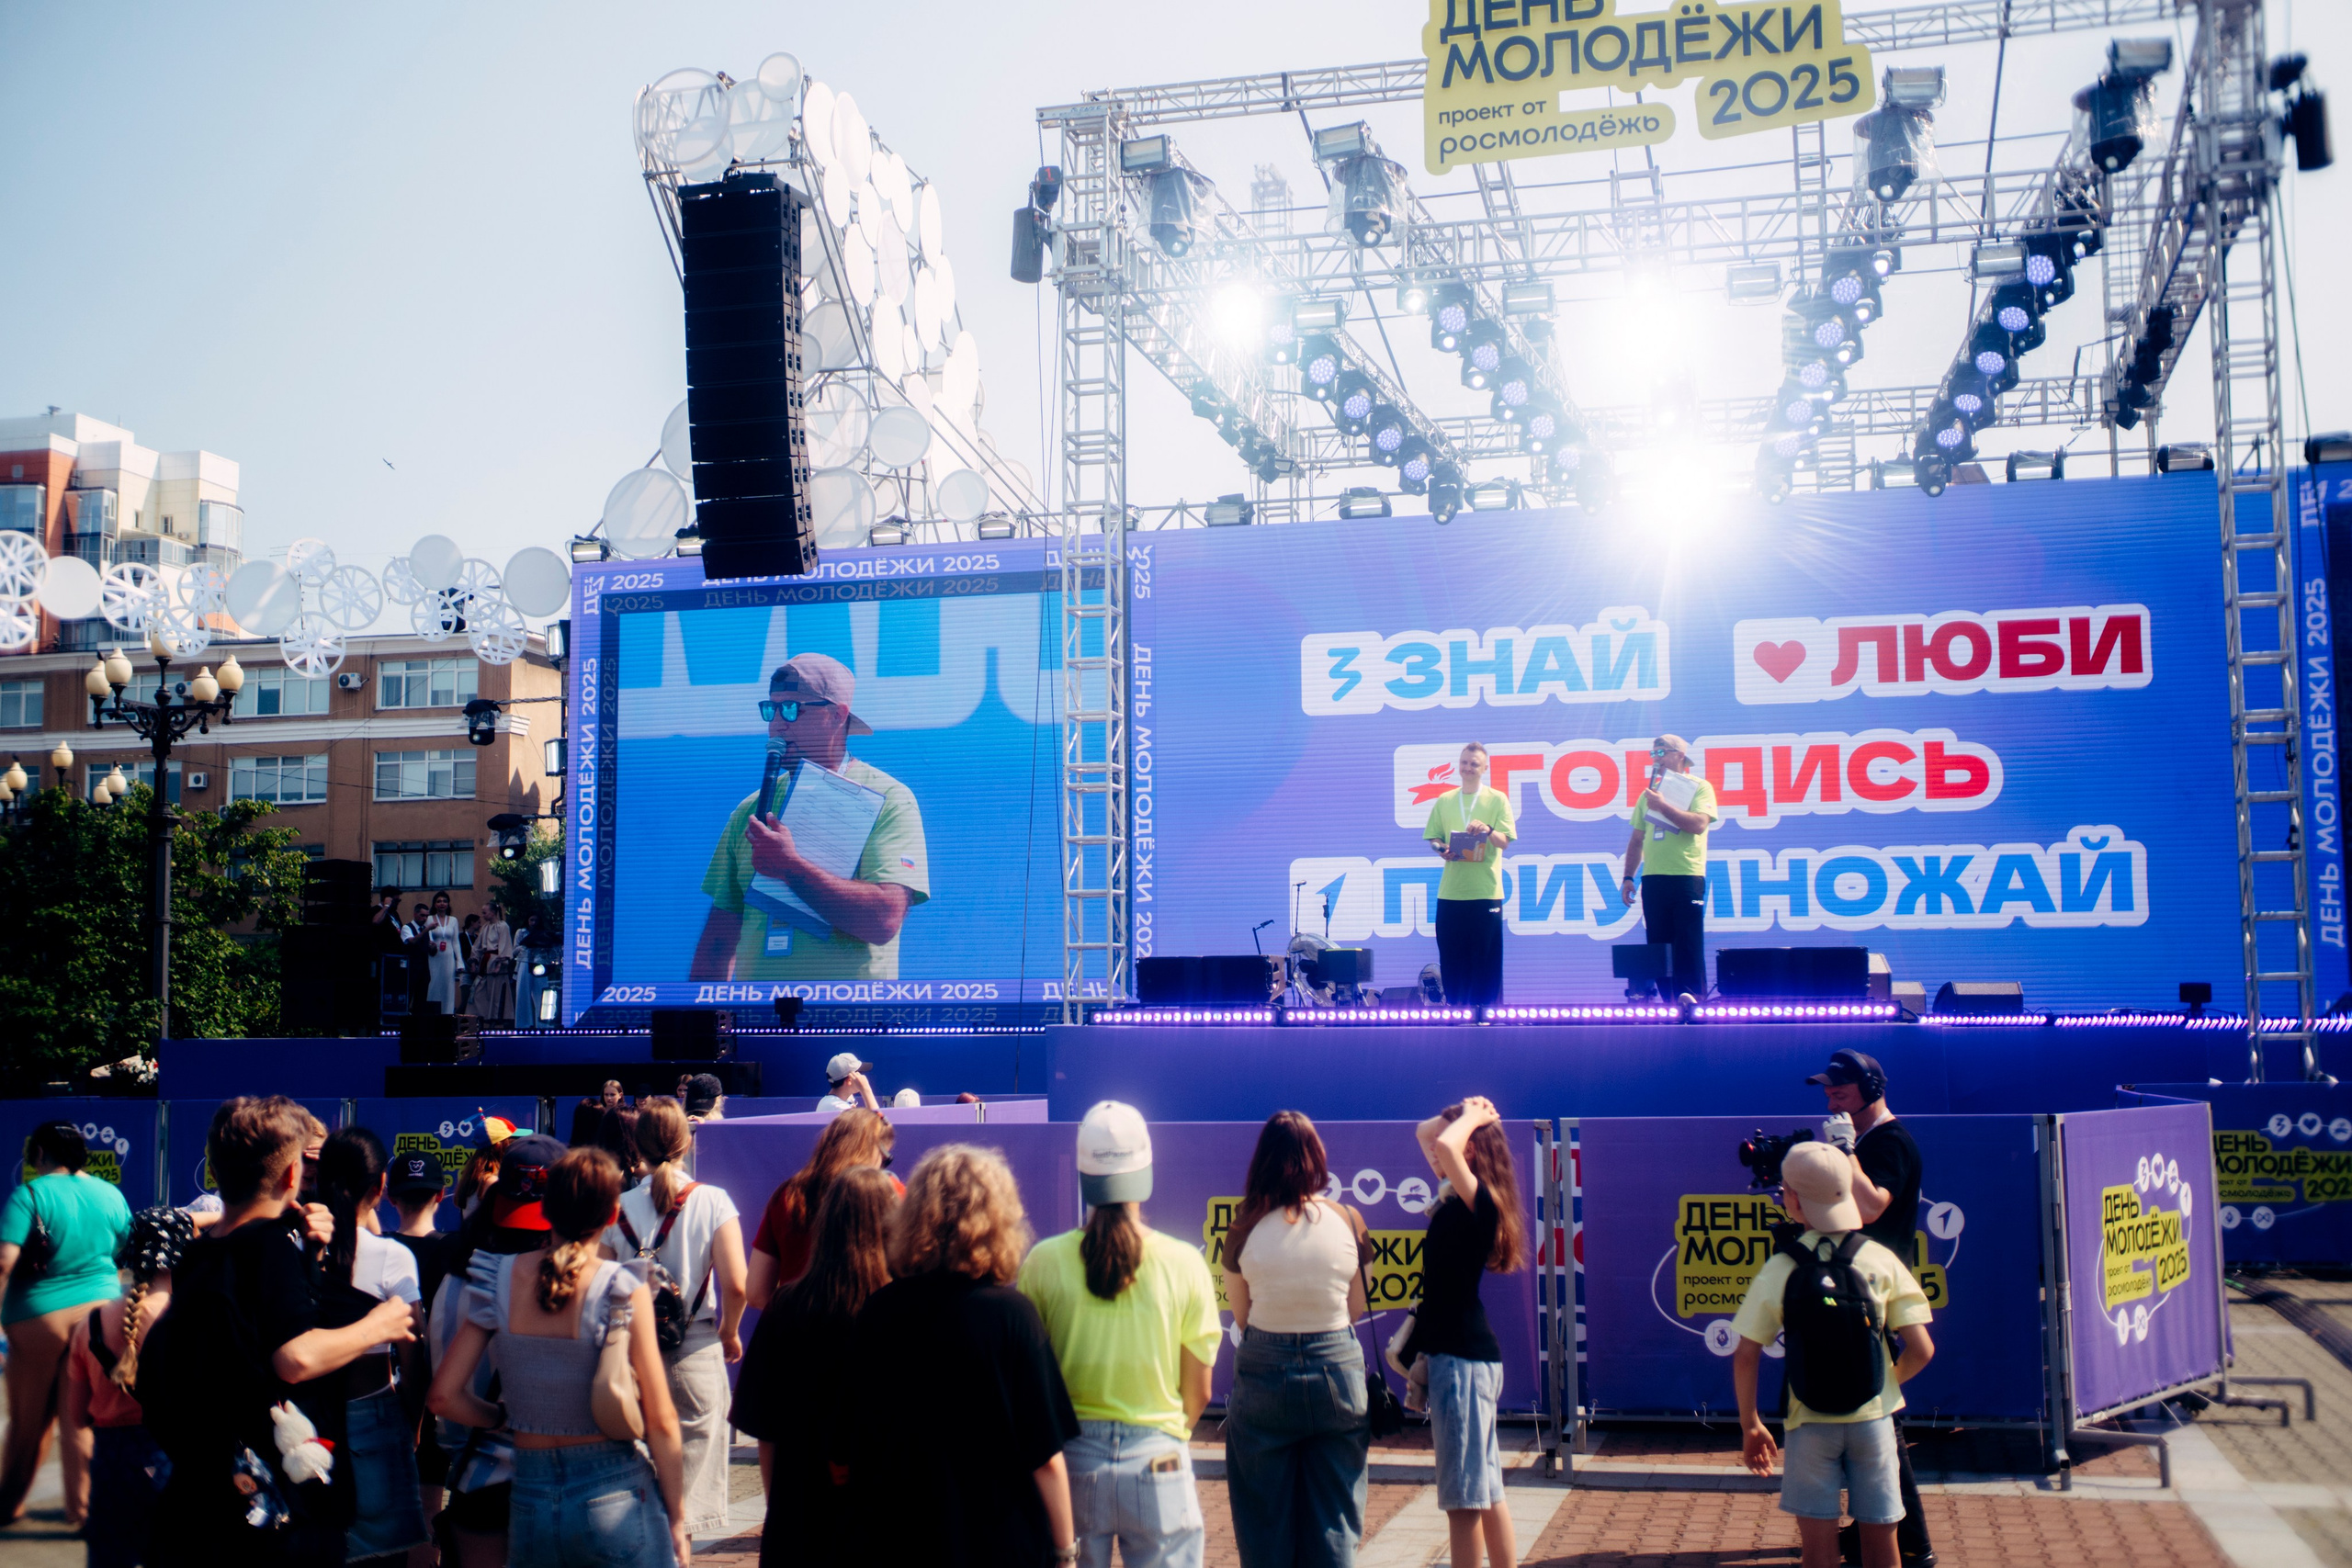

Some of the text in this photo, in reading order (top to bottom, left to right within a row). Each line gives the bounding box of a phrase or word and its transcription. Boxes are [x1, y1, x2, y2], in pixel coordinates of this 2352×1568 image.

[1442, 4, 1823, 89] МОЛОДЁЖИ
[1709, 56, 1860, 127] 2025
[1438, 100, 1547, 125] проект от
[1440, 113, 1661, 164] росмолодёжь
[611, 573, 664, 591] 2025
[775, 557, 934, 581] ОЛОДЁЖИ
[943, 554, 1000, 572] 2025
[942, 578, 1000, 595] 2025
[1384, 617, 1659, 699] ЗНАЙ
[1831, 615, 2143, 687] ЛЮБИ
[2307, 578, 2345, 948] ДЕНЬ МОЛОДЁЖИ 2025
[576, 657, 597, 970] ДЕНЬ МОЛОДЁЖИ 2025
[1133, 643, 1155, 958] ДЕНЬ МОЛОДЁЖИ 202
[602, 986, 656, 1002] 2025
[695, 985, 763, 1003] ДЕНЬ
[769, 981, 933, 1002] МОЛОДЁЖИ
[940, 983, 999, 1000] 2025
[396, 1136, 438, 1152] ДЕНЬ
[2307, 1177, 2352, 1198] 202
[2104, 1191, 2140, 1228] ДЕНЬ
[2106, 1213, 2181, 1258] МОЛОДЁЖИ
[1683, 1275, 1752, 1288] проект от
[2159, 1247, 2188, 1285] 2025
[1367, 1272, 1424, 1303] 202
